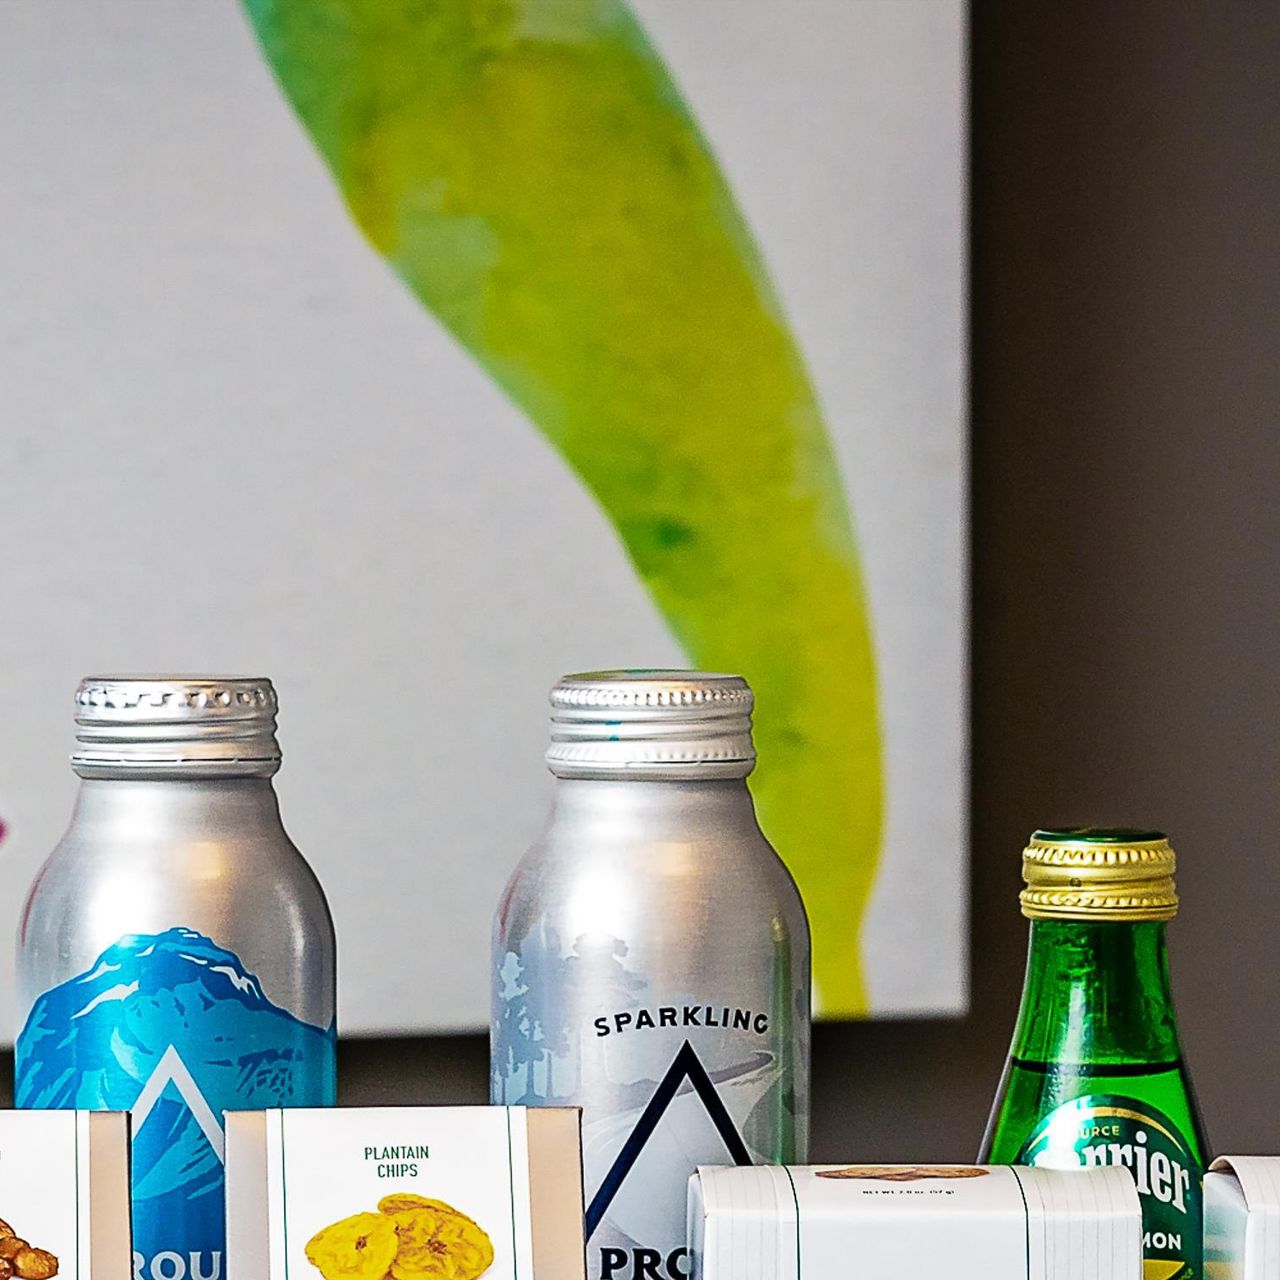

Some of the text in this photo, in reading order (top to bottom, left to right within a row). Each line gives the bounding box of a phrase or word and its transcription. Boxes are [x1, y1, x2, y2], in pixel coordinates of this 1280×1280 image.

[594, 1006, 768, 1037] SPARKLING
[364, 1145, 429, 1160] PLANTAIN
[377, 1163, 418, 1178] CHIPS
